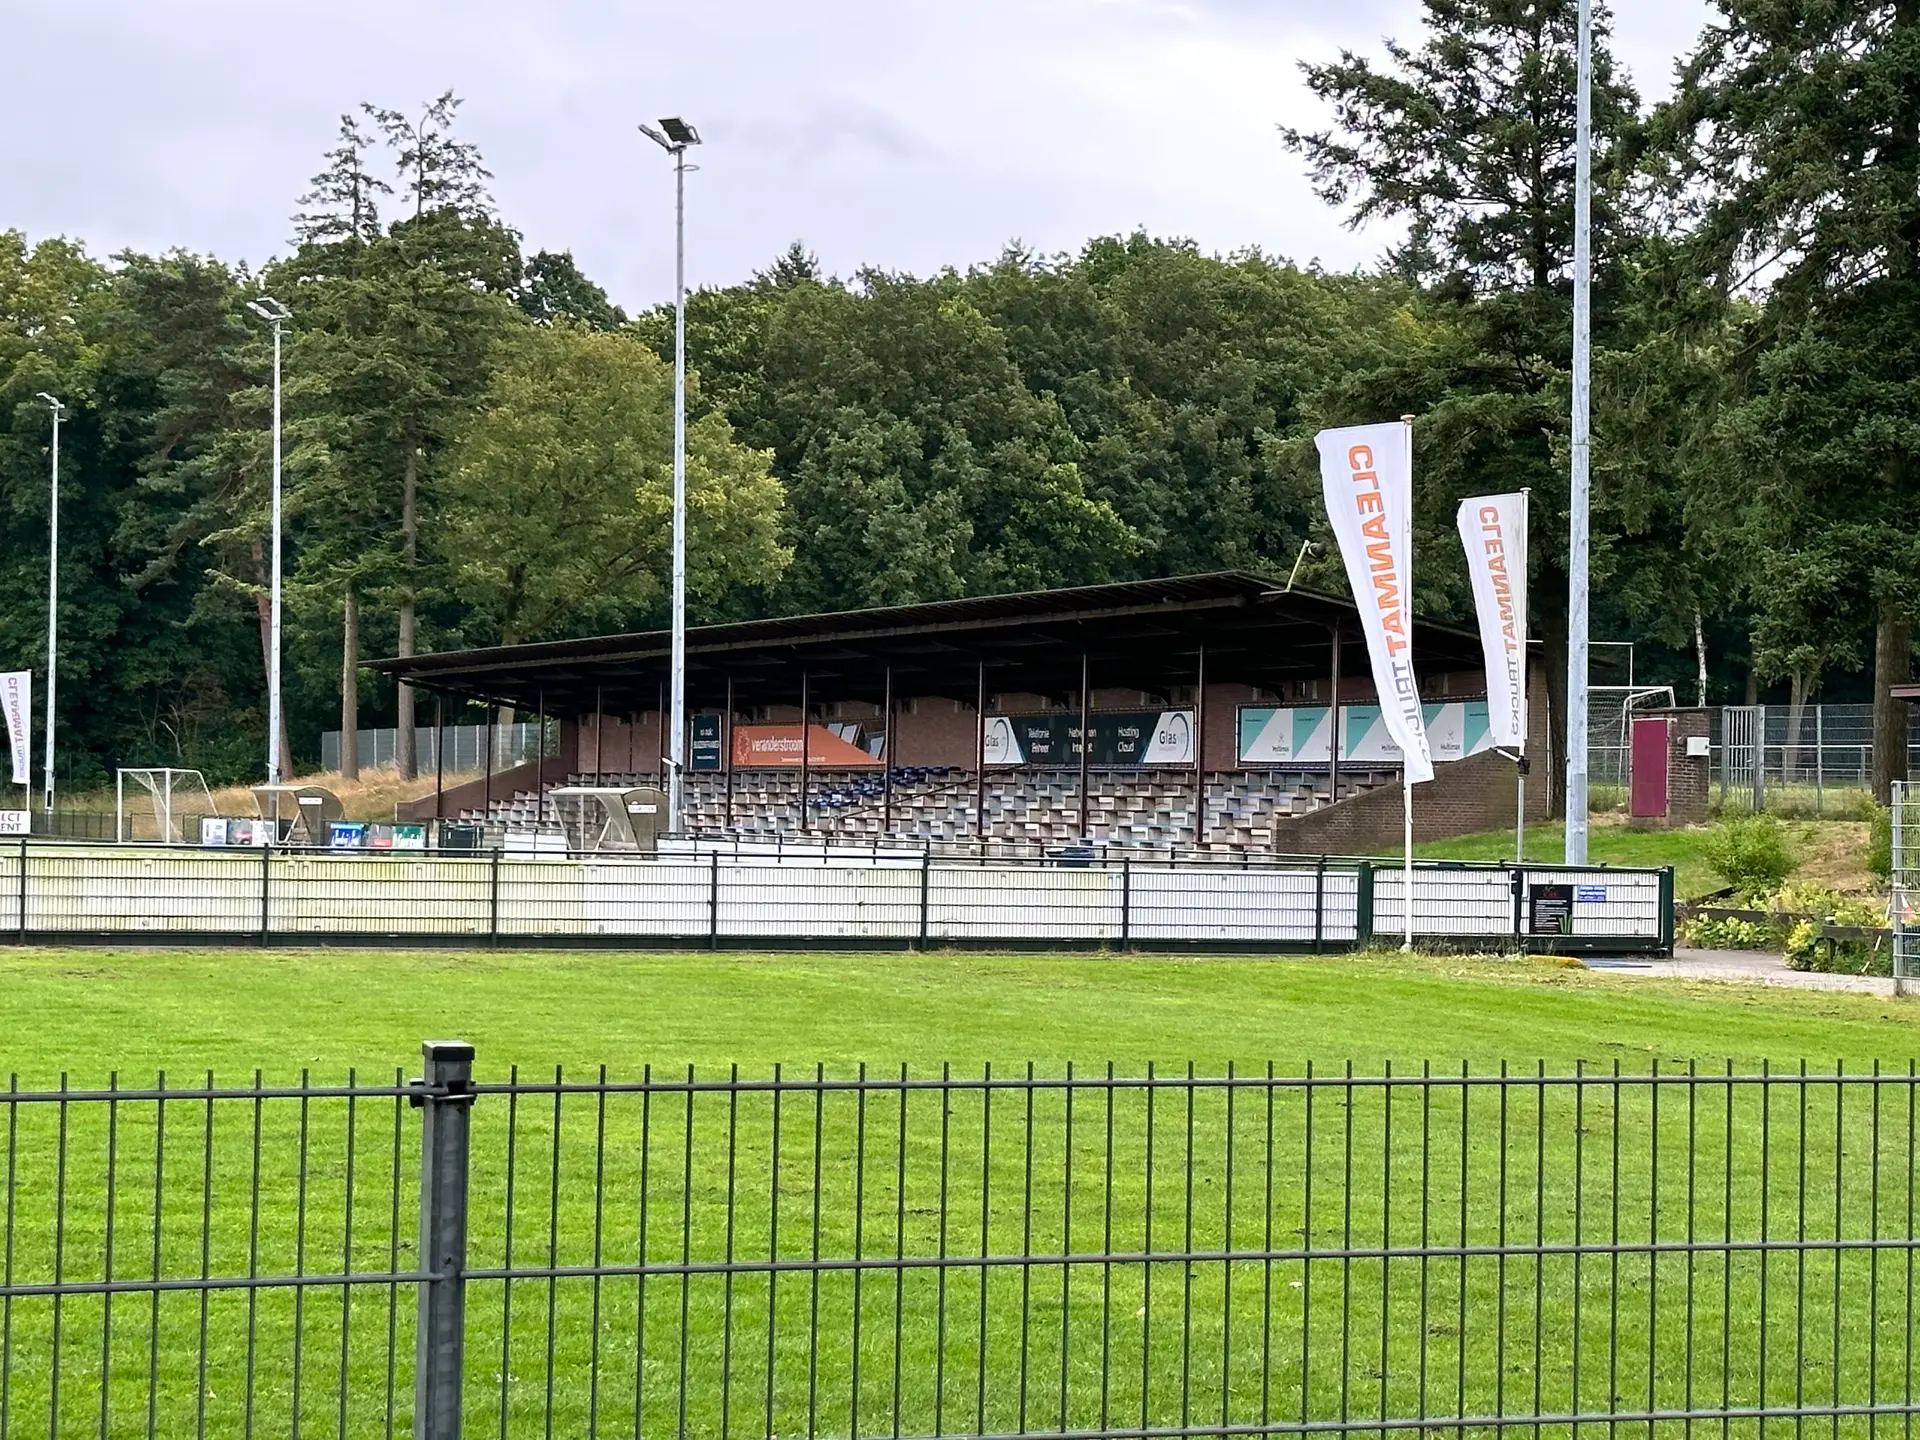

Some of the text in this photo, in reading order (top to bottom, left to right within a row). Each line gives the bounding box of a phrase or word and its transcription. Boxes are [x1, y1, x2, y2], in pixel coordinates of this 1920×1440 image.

[1117, 725, 1140, 738] Hosting
[1159, 730, 1177, 744] Glas
[751, 735, 804, 752] veranderstroom
[985, 734, 999, 747] Glas
[1117, 740, 1135, 752] Cloud
